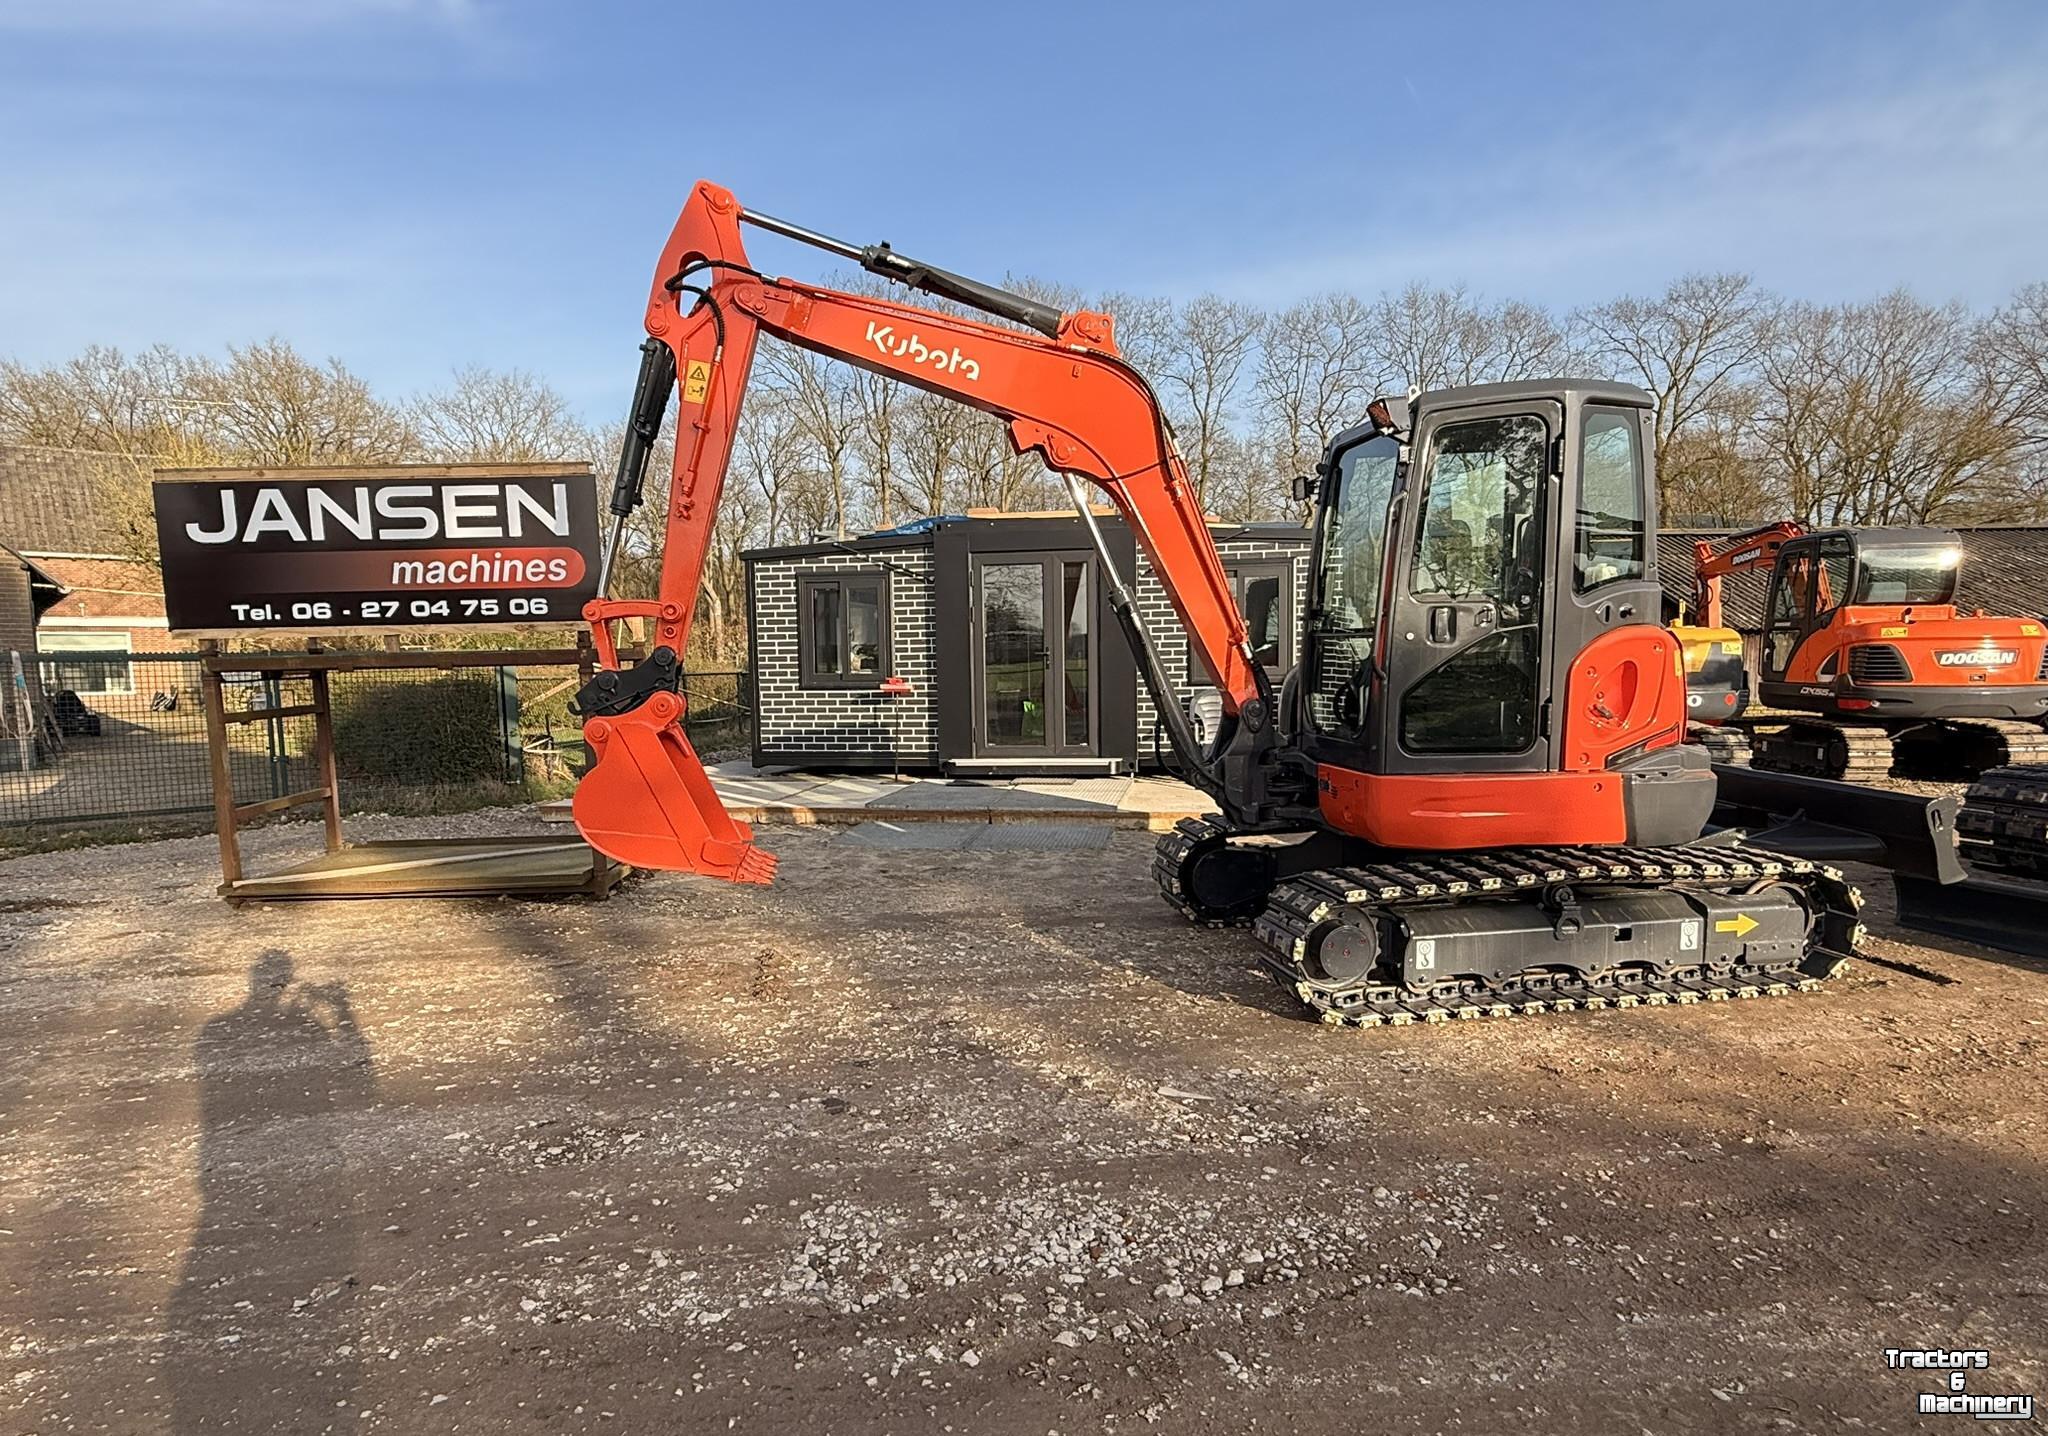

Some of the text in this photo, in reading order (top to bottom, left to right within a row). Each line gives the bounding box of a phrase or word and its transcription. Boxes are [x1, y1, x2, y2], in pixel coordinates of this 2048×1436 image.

[865, 320, 981, 381] Kubota
[185, 483, 570, 544] JANSEN
[392, 552, 568, 585] machines
[230, 603, 281, 621] Tel.
[291, 602, 332, 620] 06
[360, 601, 400, 618] 27
[410, 600, 450, 617] 04
[460, 599, 499, 616] 75
[509, 598, 549, 615] 06
[1939, 652, 2016, 665] DOOSAN
